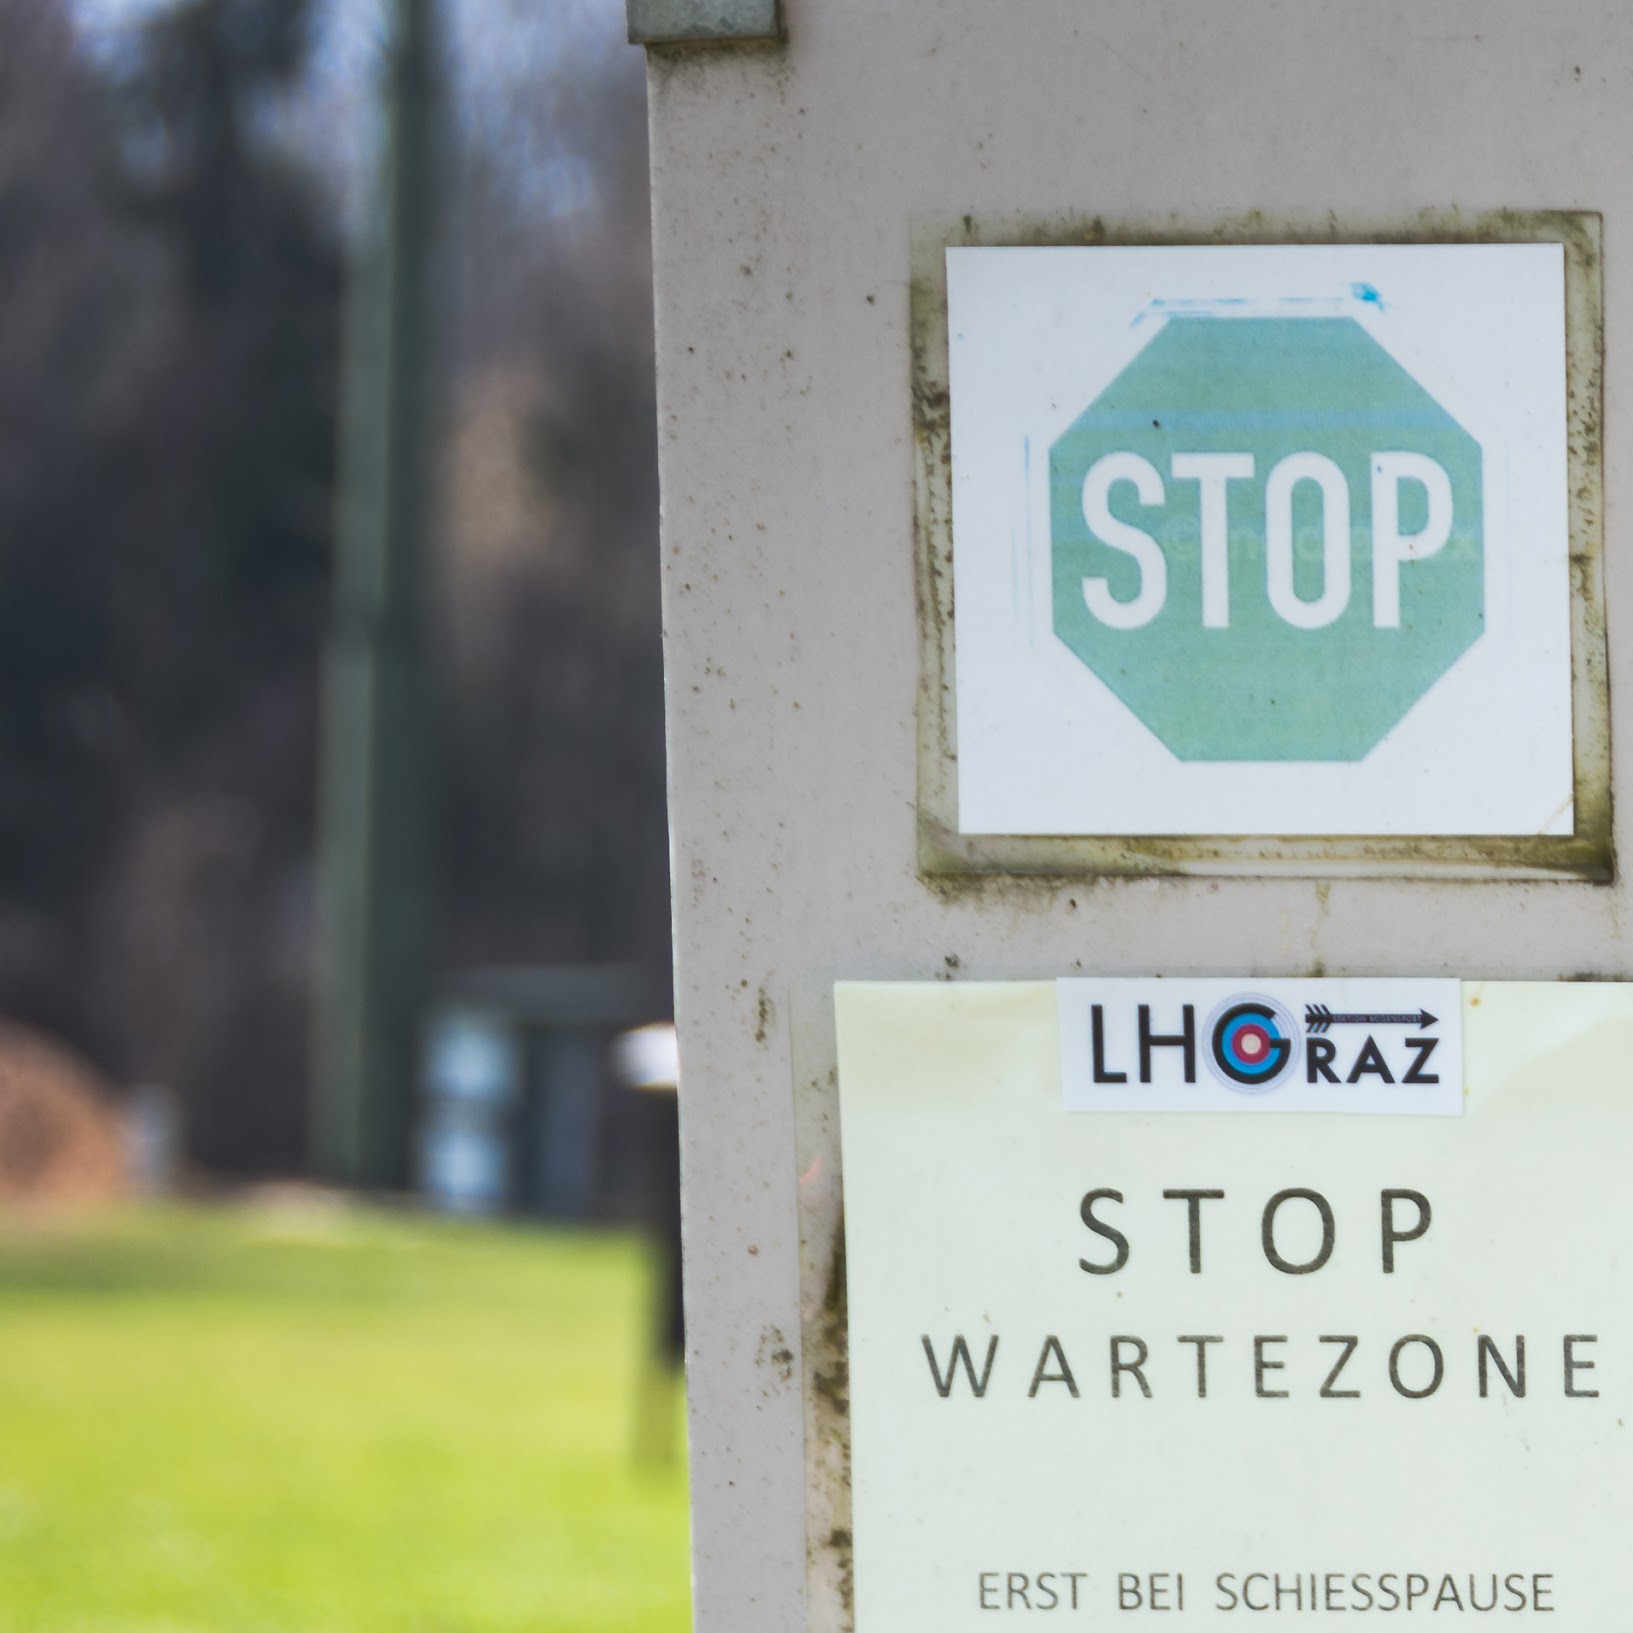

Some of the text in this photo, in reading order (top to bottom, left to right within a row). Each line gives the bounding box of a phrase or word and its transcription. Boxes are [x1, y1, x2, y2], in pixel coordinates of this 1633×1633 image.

[1081, 450, 1454, 631] STOP
[1077, 1186, 1434, 1276] STOP
[920, 1332, 1601, 1400] WARTEZONE
[978, 1572, 1556, 1612] ERST BEI SCHIESSPAUSE
